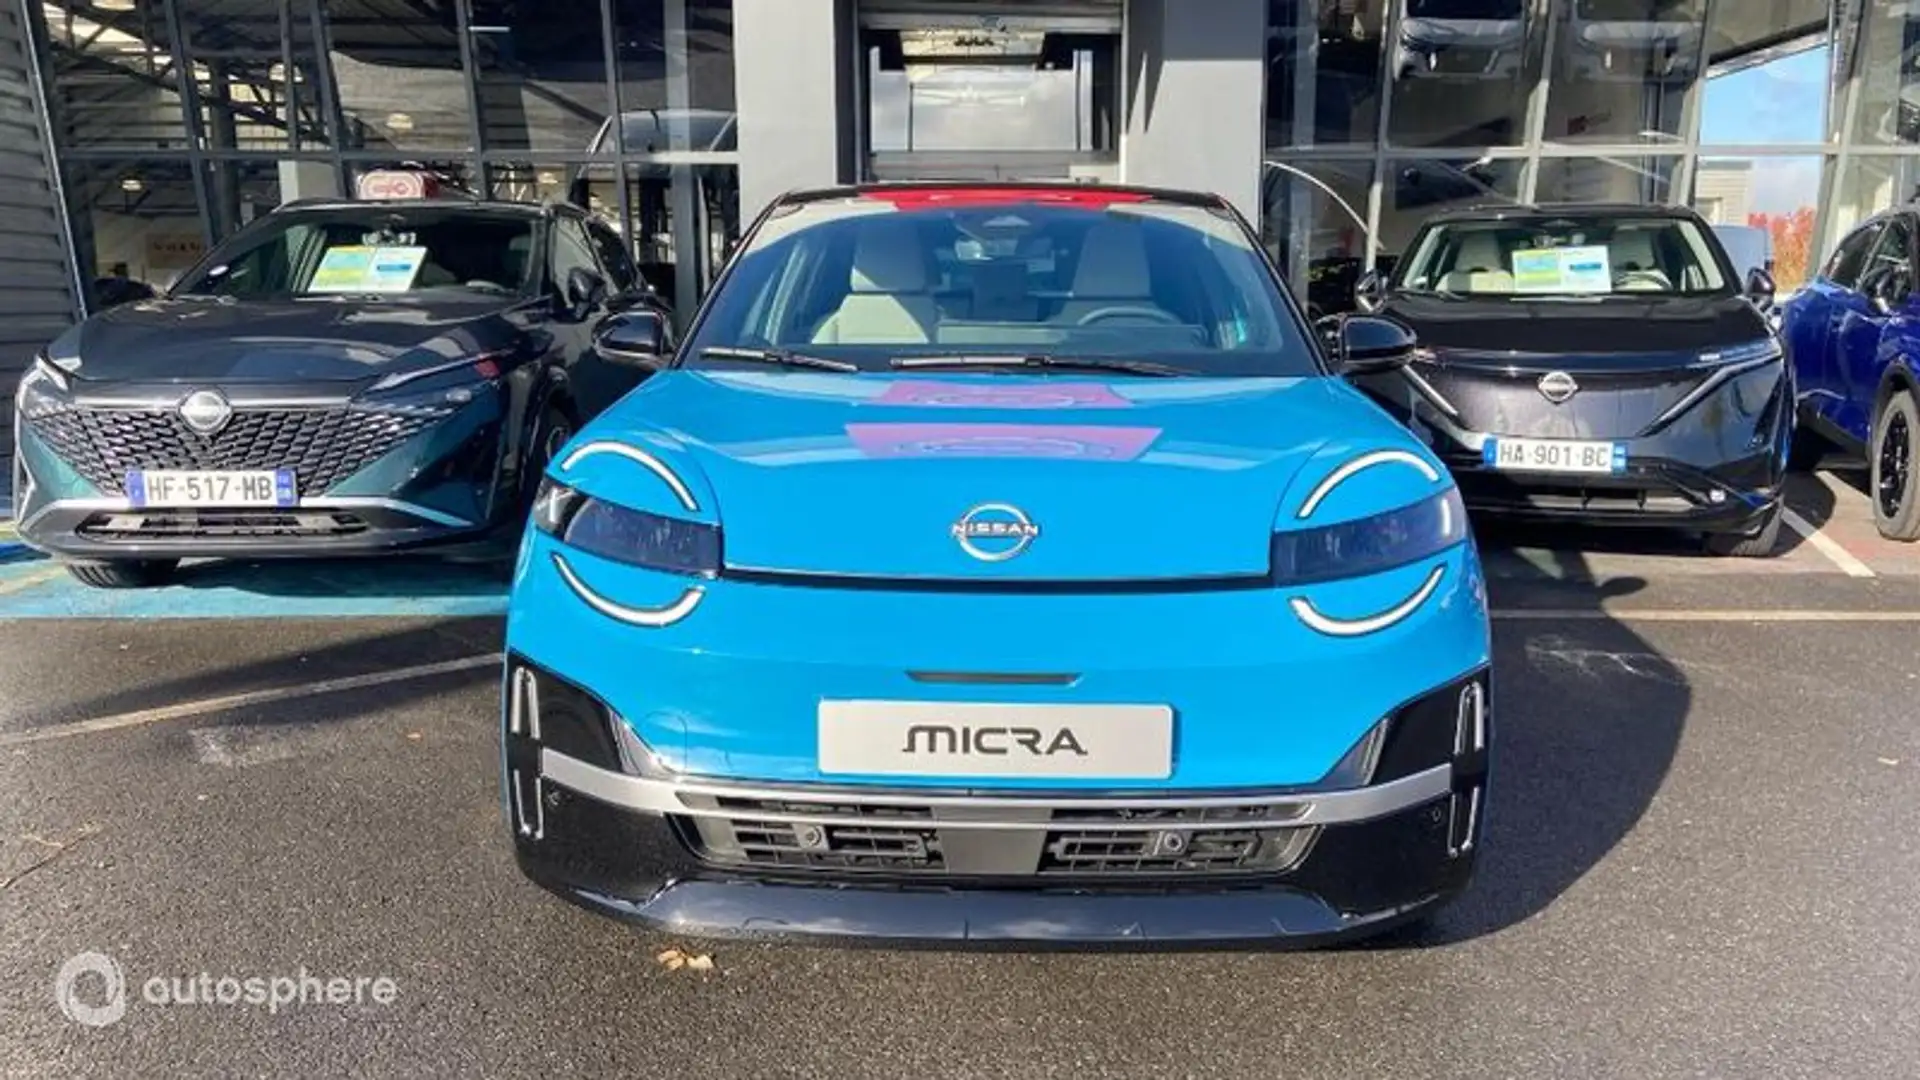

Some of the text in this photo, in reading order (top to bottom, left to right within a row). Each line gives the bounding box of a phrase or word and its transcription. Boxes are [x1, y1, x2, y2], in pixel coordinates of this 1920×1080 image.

[1500, 443, 1609, 467] HA-901-BC
[951, 522, 1039, 536] NISSAN
[902, 725, 1089, 755] MICRA
